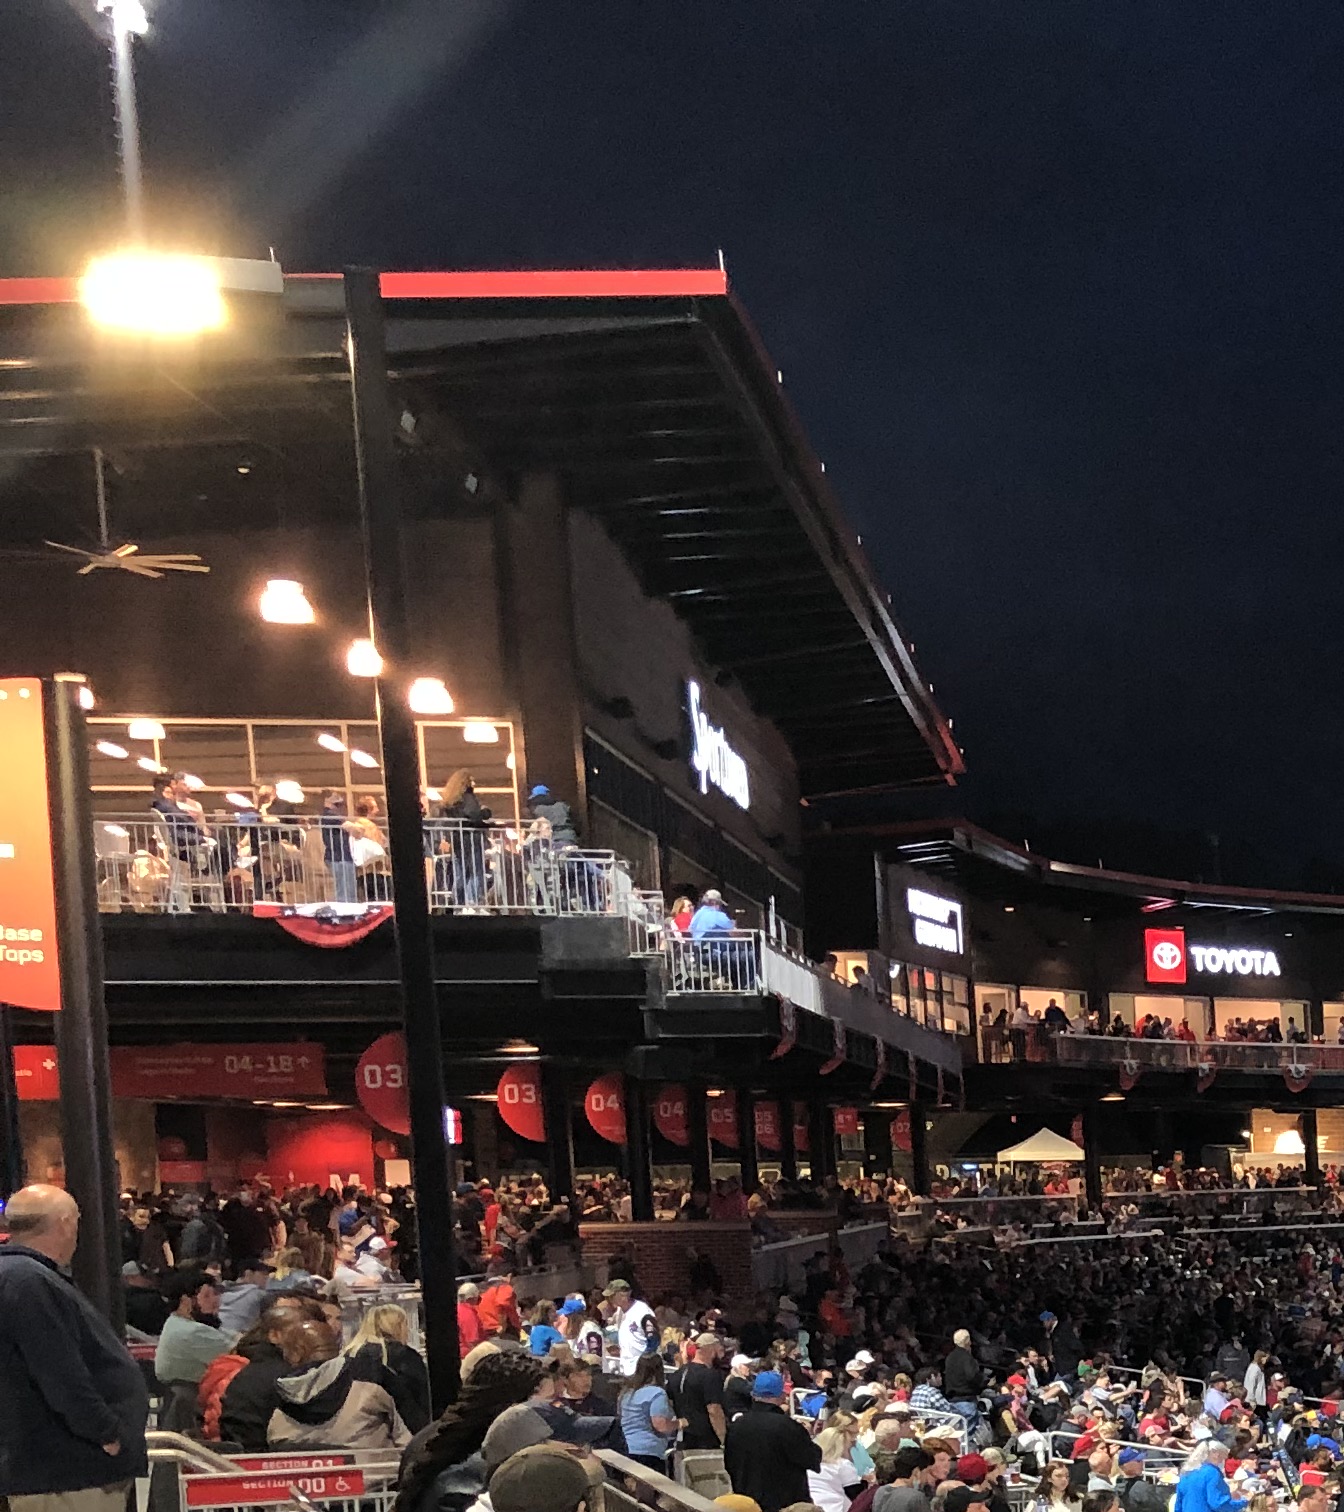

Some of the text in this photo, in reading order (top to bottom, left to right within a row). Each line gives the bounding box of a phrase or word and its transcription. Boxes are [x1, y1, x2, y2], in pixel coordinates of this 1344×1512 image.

[1190, 946, 1281, 976] TOYOTA
[364, 1064, 403, 1089] 03
[504, 1084, 537, 1104] 03
[592, 1094, 620, 1112] 04
[659, 1101, 685, 1118] 04
[262, 1460, 308, 1470] SECTION
[242, 1477, 325, 1493] SECTION 00
